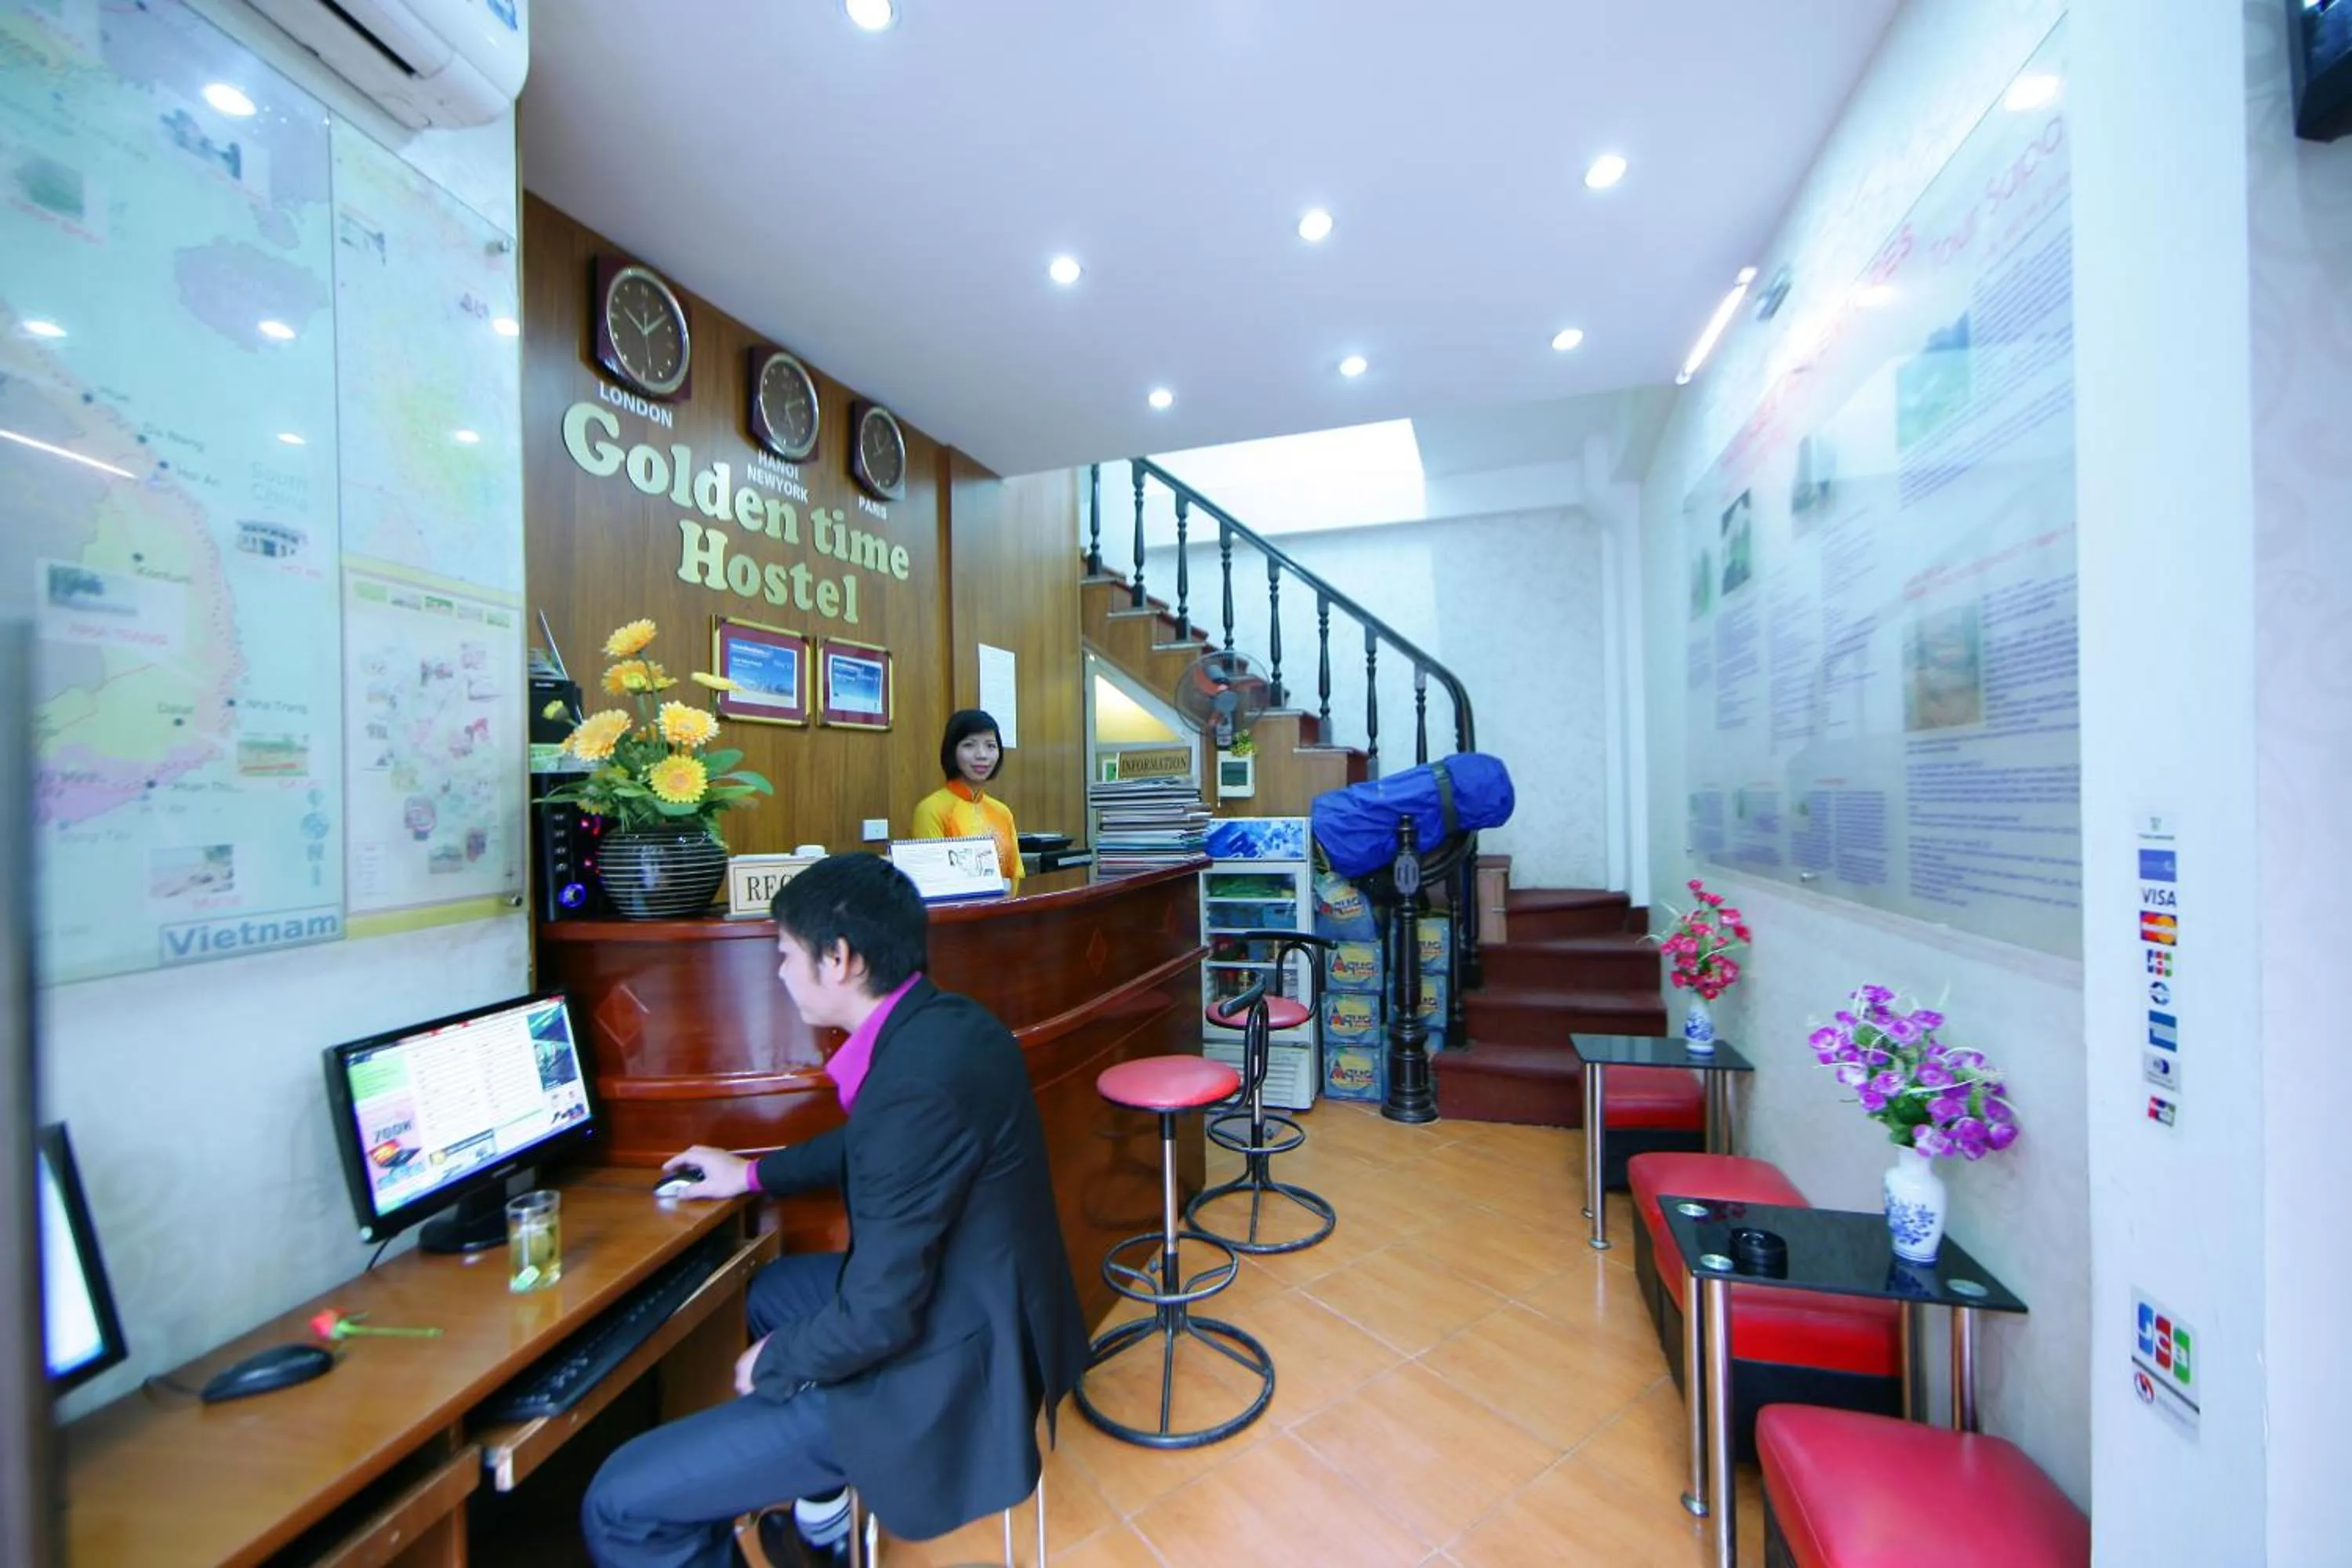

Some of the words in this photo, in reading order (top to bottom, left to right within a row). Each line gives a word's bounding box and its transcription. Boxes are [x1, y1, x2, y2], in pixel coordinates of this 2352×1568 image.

[600, 382, 673, 428] LONDON
[747, 463, 808, 504] NEWYORK
[758, 448, 800, 481] HANOI
[562, 401, 800, 544] Golden
[811, 503, 910, 580] time
[677, 520, 858, 625] Hostel
[1121, 755, 1187, 772] INFORMATION
[2141, 887, 2177, 907] VISA
[165, 913, 338, 956] Vietnam
